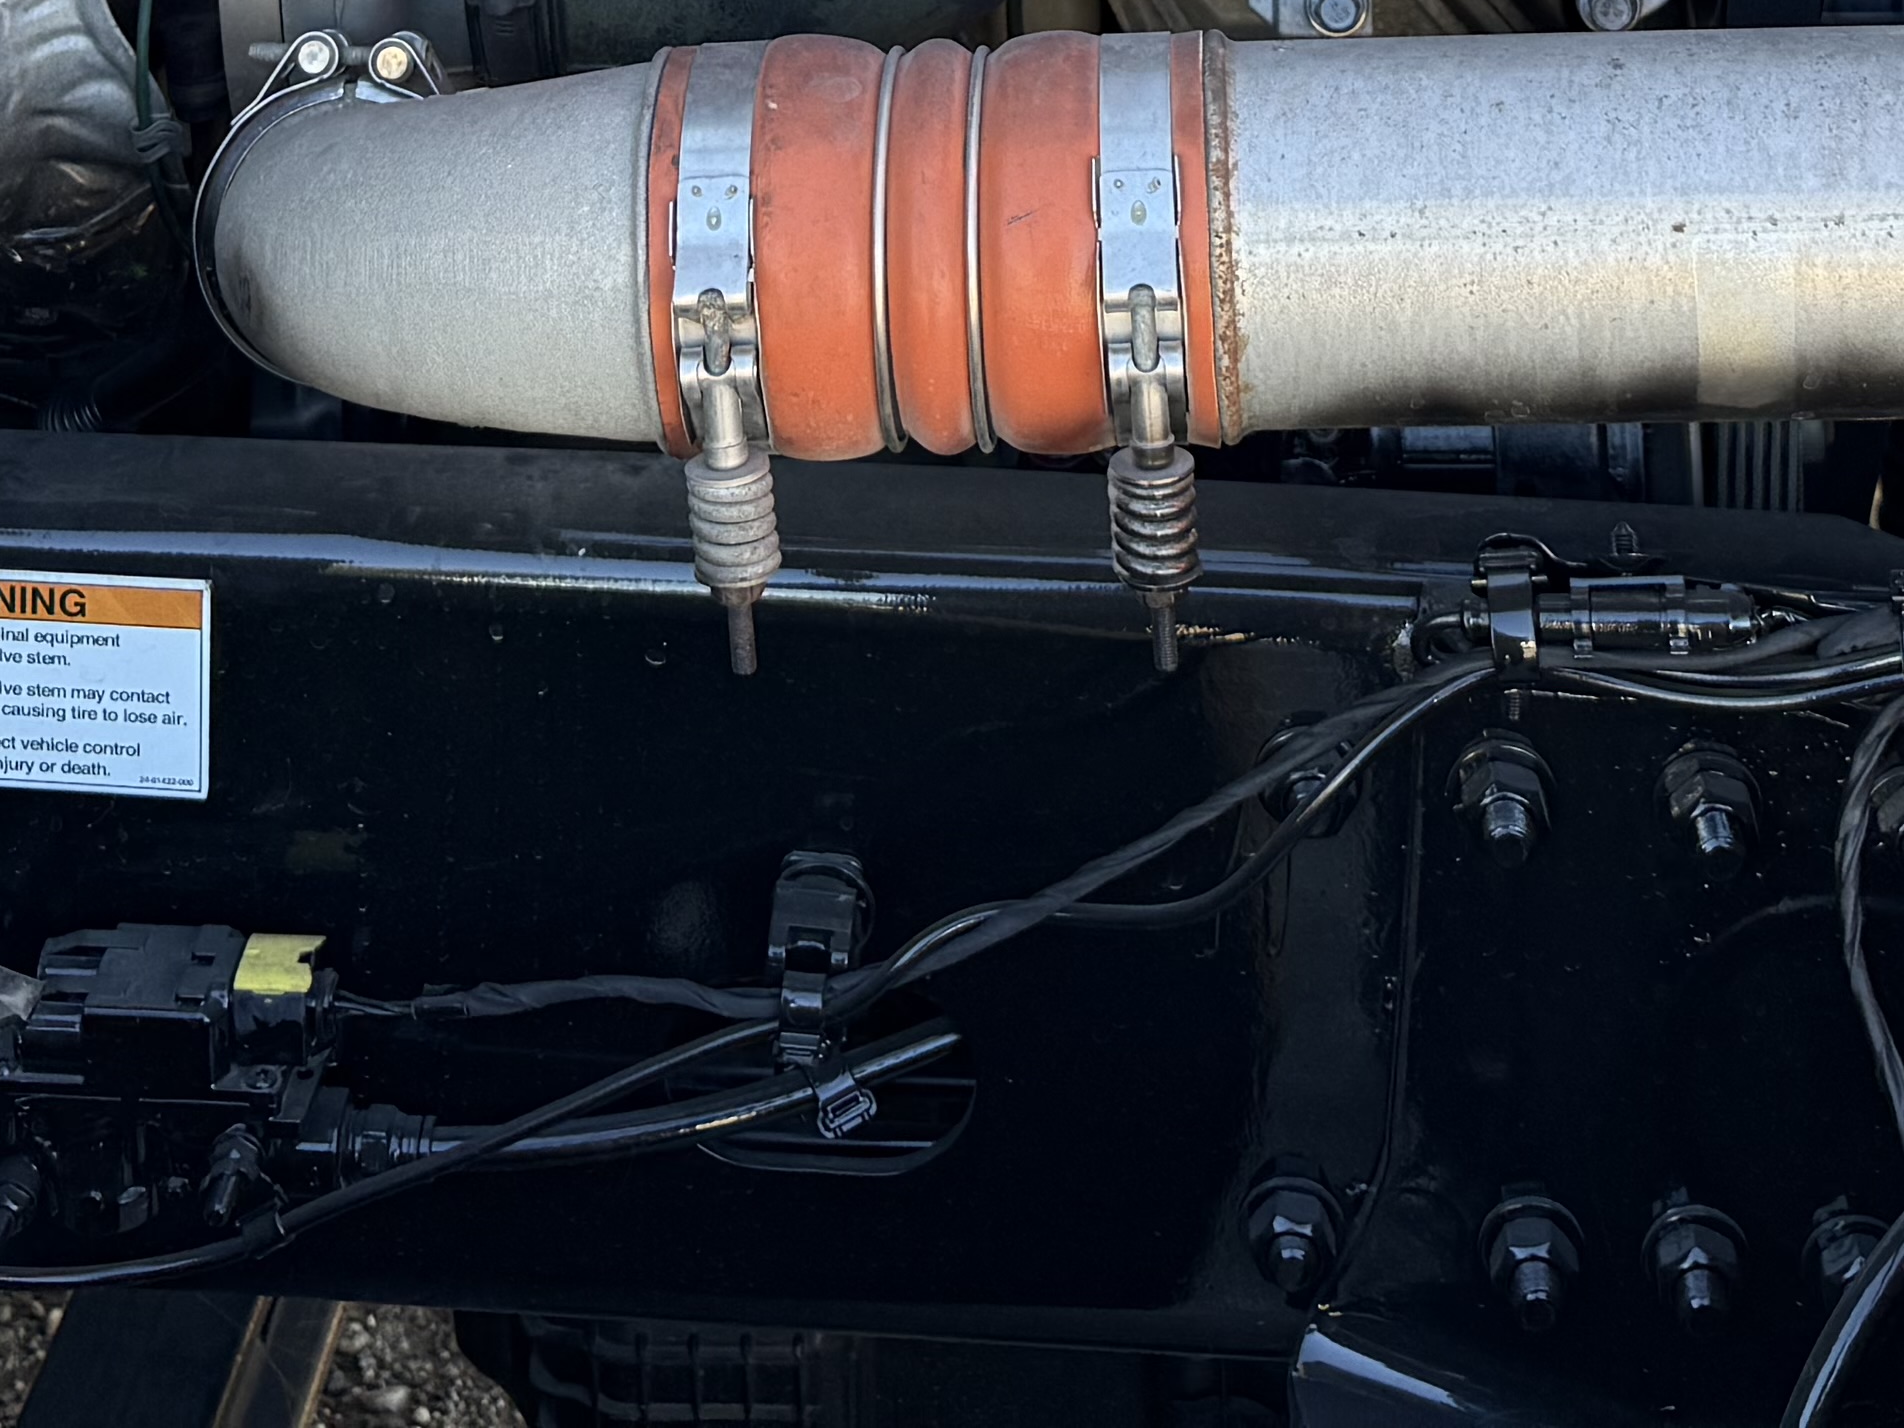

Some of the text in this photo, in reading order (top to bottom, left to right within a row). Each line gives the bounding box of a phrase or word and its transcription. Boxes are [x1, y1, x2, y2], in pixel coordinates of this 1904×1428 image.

[34, 630, 120, 649] equipment
[27, 650, 71, 667] stem.
[26, 682, 67, 698] stem
[72, 687, 105, 704] may
[110, 687, 170, 704] contact
[2, 701, 66, 723] causing
[71, 703, 97, 720] tire
[102, 705, 119, 721] to
[124, 706, 157, 724] lose
[162, 709, 187, 726] air.
[20, 735, 79, 753] vehicle
[84, 738, 140, 757] control
[39, 759, 56, 774] or
[61, 758, 111, 777] death.
